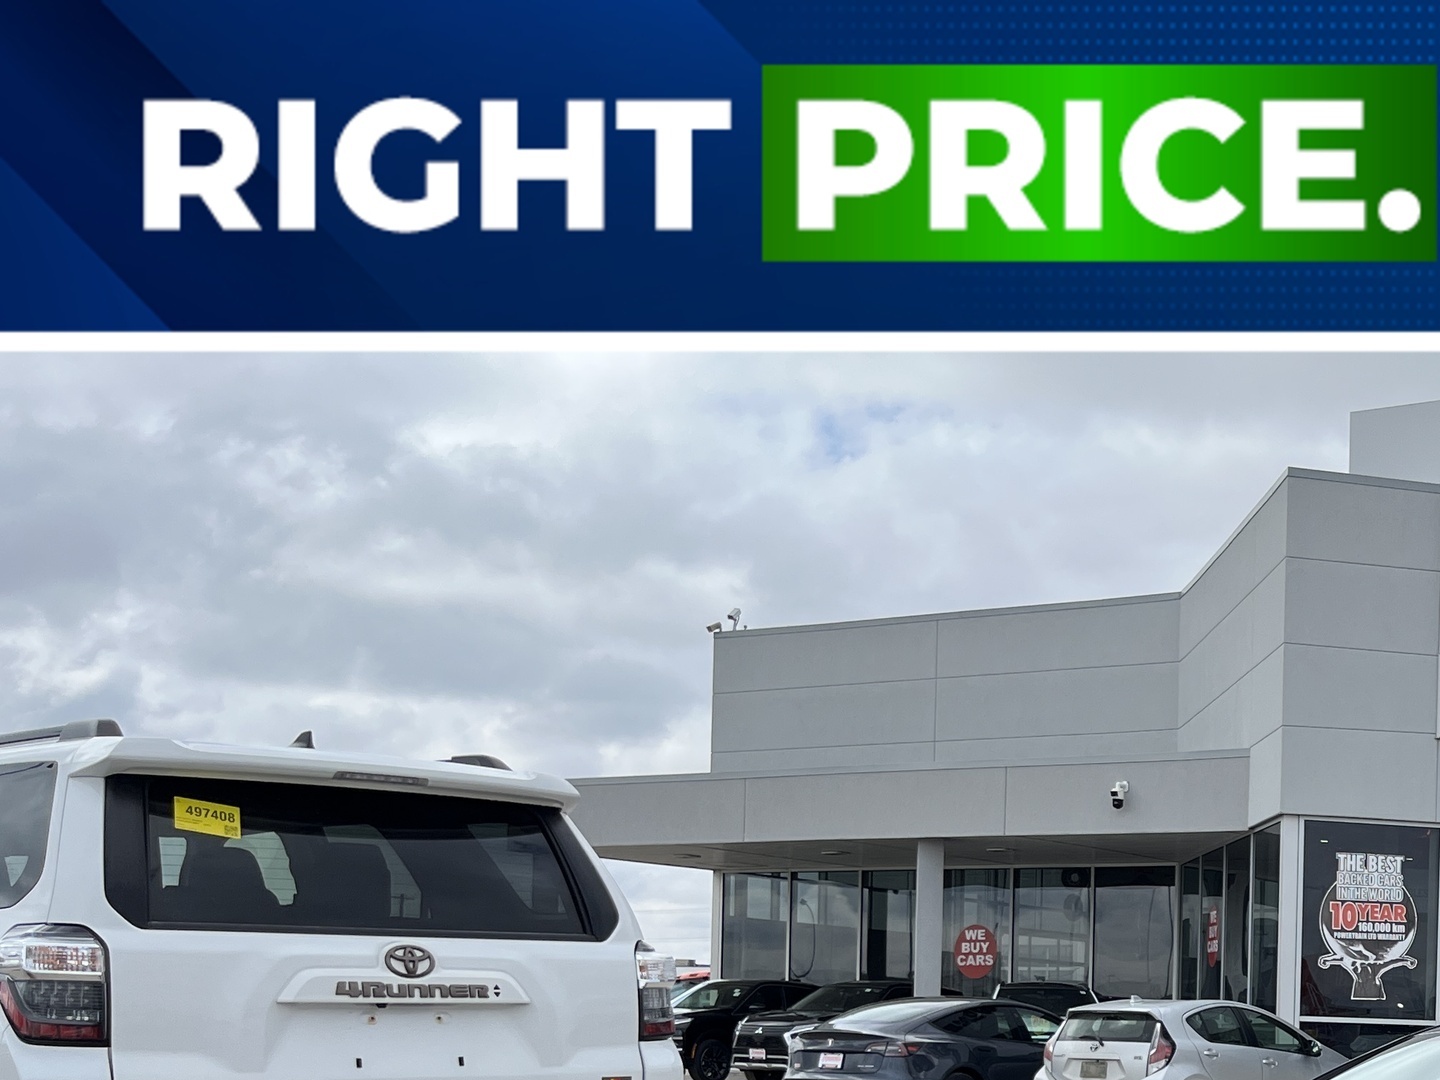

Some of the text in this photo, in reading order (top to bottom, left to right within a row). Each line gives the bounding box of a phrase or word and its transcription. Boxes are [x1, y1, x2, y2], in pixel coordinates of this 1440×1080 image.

[186, 805, 236, 823] 497408
[1337, 853, 1404, 874] THE BEST
[1337, 872, 1375, 886] BACKED
[1337, 887, 1348, 900] IN
[1349, 887, 1367, 901] THE
[1368, 888, 1403, 901] WORLD
[1330, 901, 1407, 930] 10 YEAR
[965, 929, 986, 940] WE
[1358, 922, 1405, 933] 160,000 km
[961, 942, 989, 953] BUY
[957, 955, 994, 966] CARS
